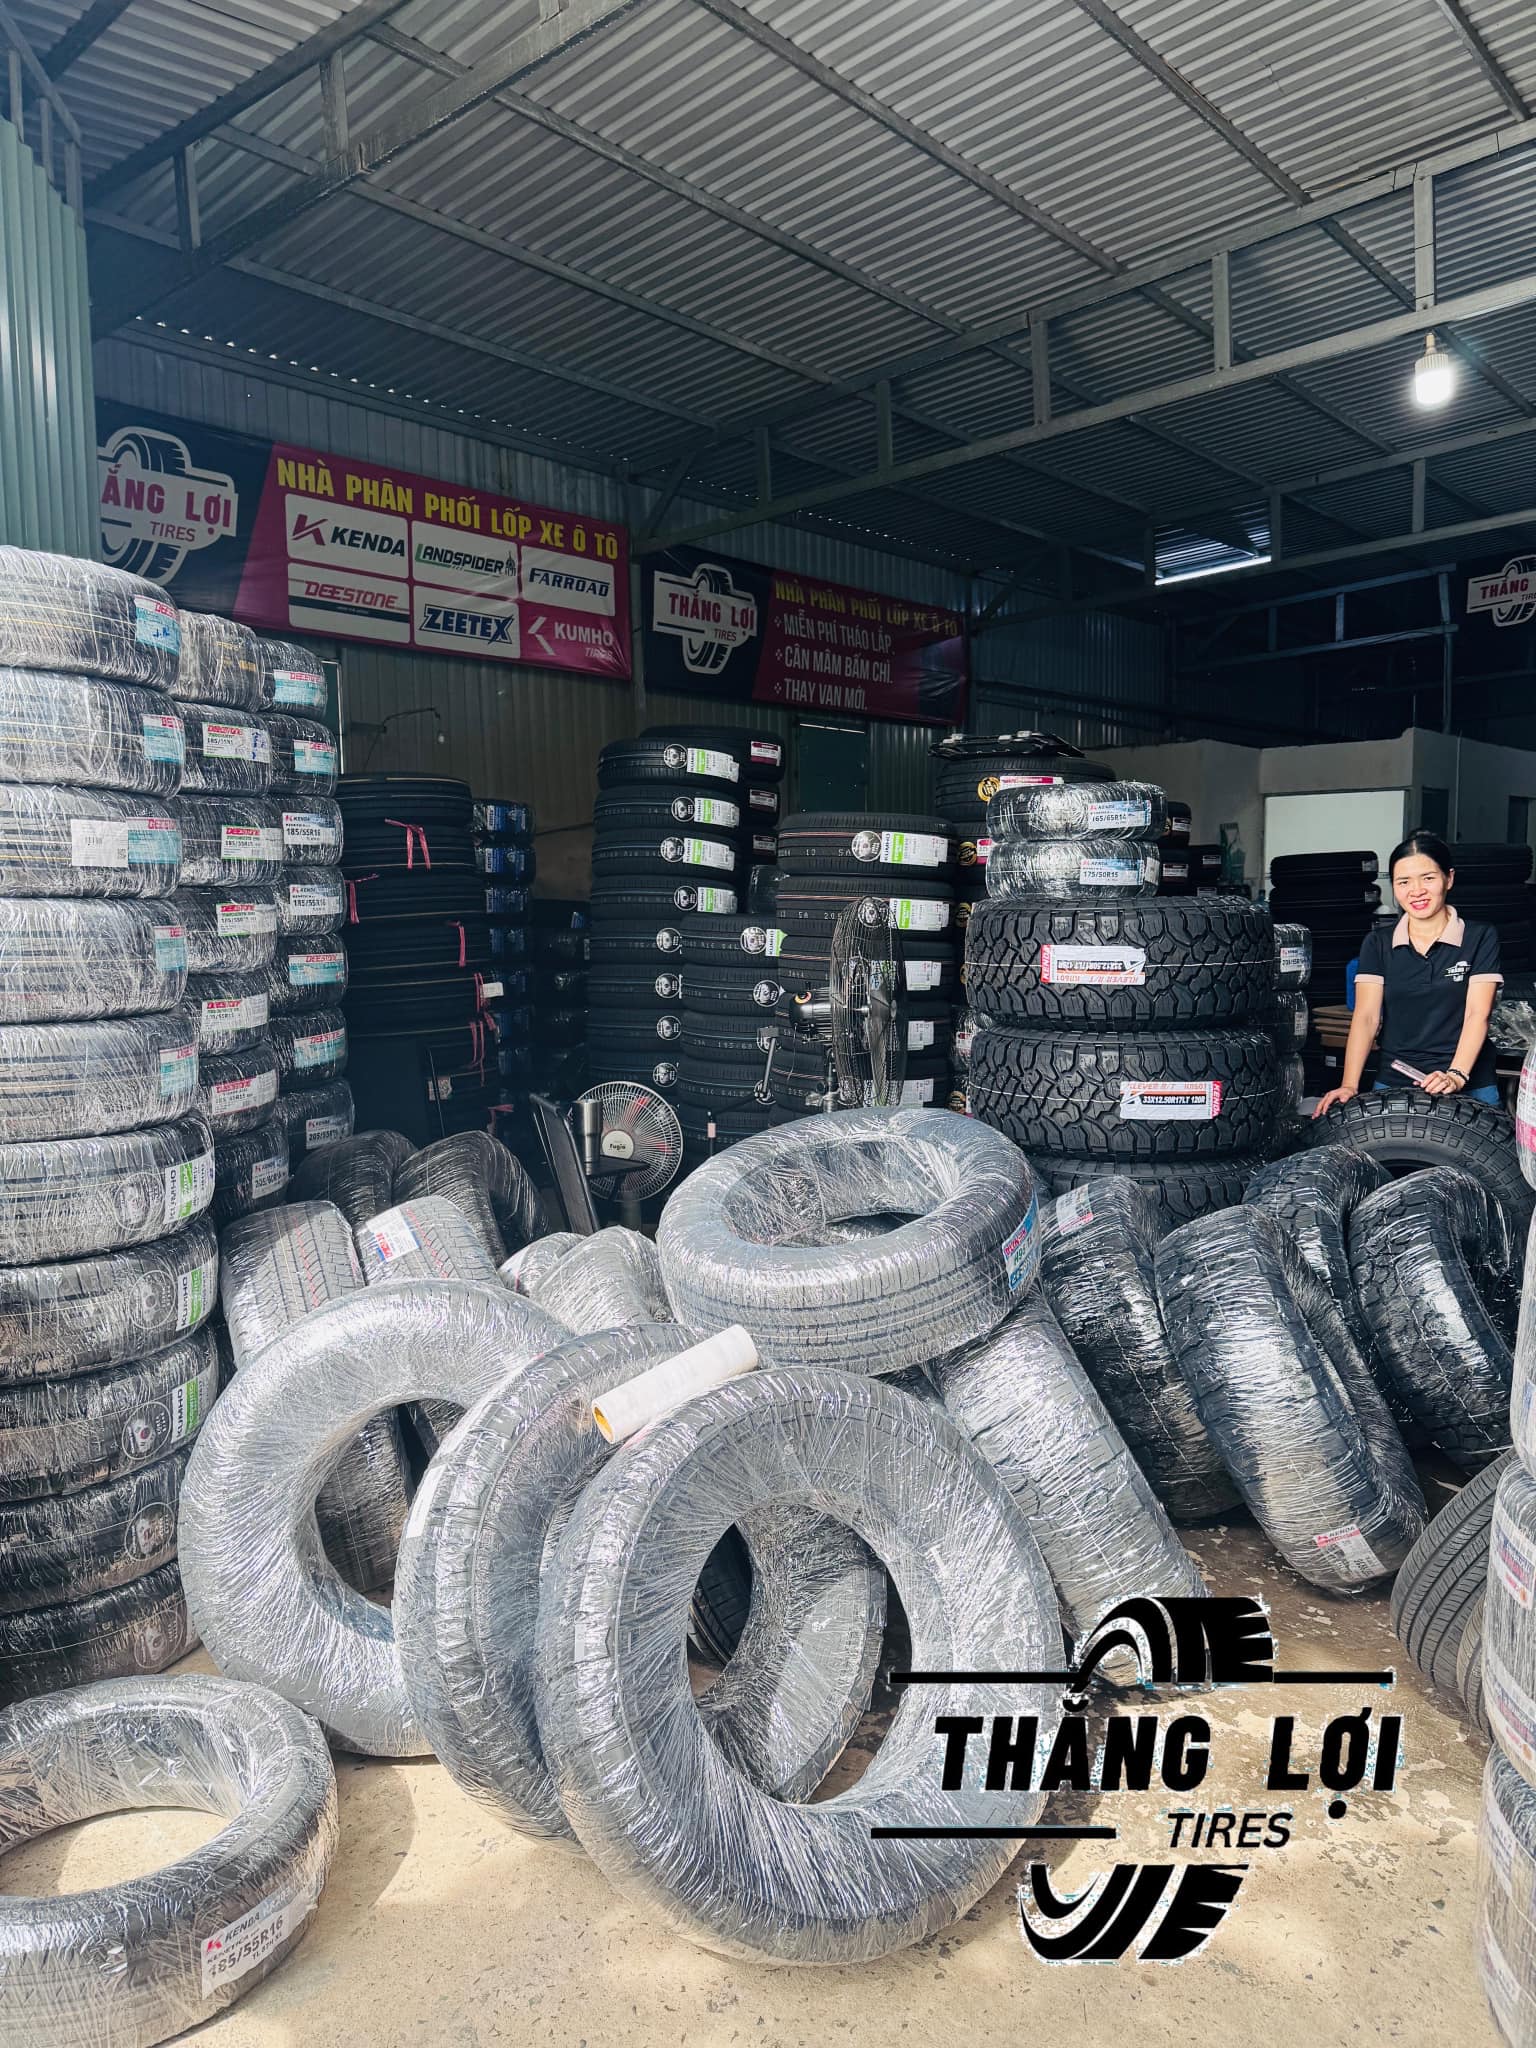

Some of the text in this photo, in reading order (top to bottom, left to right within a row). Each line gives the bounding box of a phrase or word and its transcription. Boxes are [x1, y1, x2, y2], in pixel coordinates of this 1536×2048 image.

[101, 463, 231, 535] ẮNG LỢI
[277, 457, 618, 560] NHÀ PHÂN PHỐI LỐP XE Ô TÔ
[150, 521, 196, 542] TIRES
[330, 526, 405, 557] KENDA
[414, 543, 504, 574] LANDSPIDER
[304, 580, 399, 609] DEESTONE
[528, 567, 610, 597] FARROAD
[775, 578, 805, 605] NHÀ
[810, 588, 845, 613] PHÂN
[422, 607, 513, 644] ZEETEX
[668, 588, 754, 635] THẮNG LỢI
[554, 621, 613, 646] KUMHO
[713, 628, 737, 642] TIRES
[783, 608, 815, 640] MIỄN
[818, 617, 838, 645] PHÍ
[840, 622, 869, 648] THÁO
[784, 645, 809, 670] CÂN
[813, 649, 842, 677] MÂM
[783, 678, 816, 703] THAY
[818, 683, 843, 707] VAN
[1042, 945, 1050, 979] KENDA
[1212, 1083, 1221, 1118] KENDA
[225, 1912, 260, 1942] KENDA
[209, 1915, 283, 1977] 185/55R16
